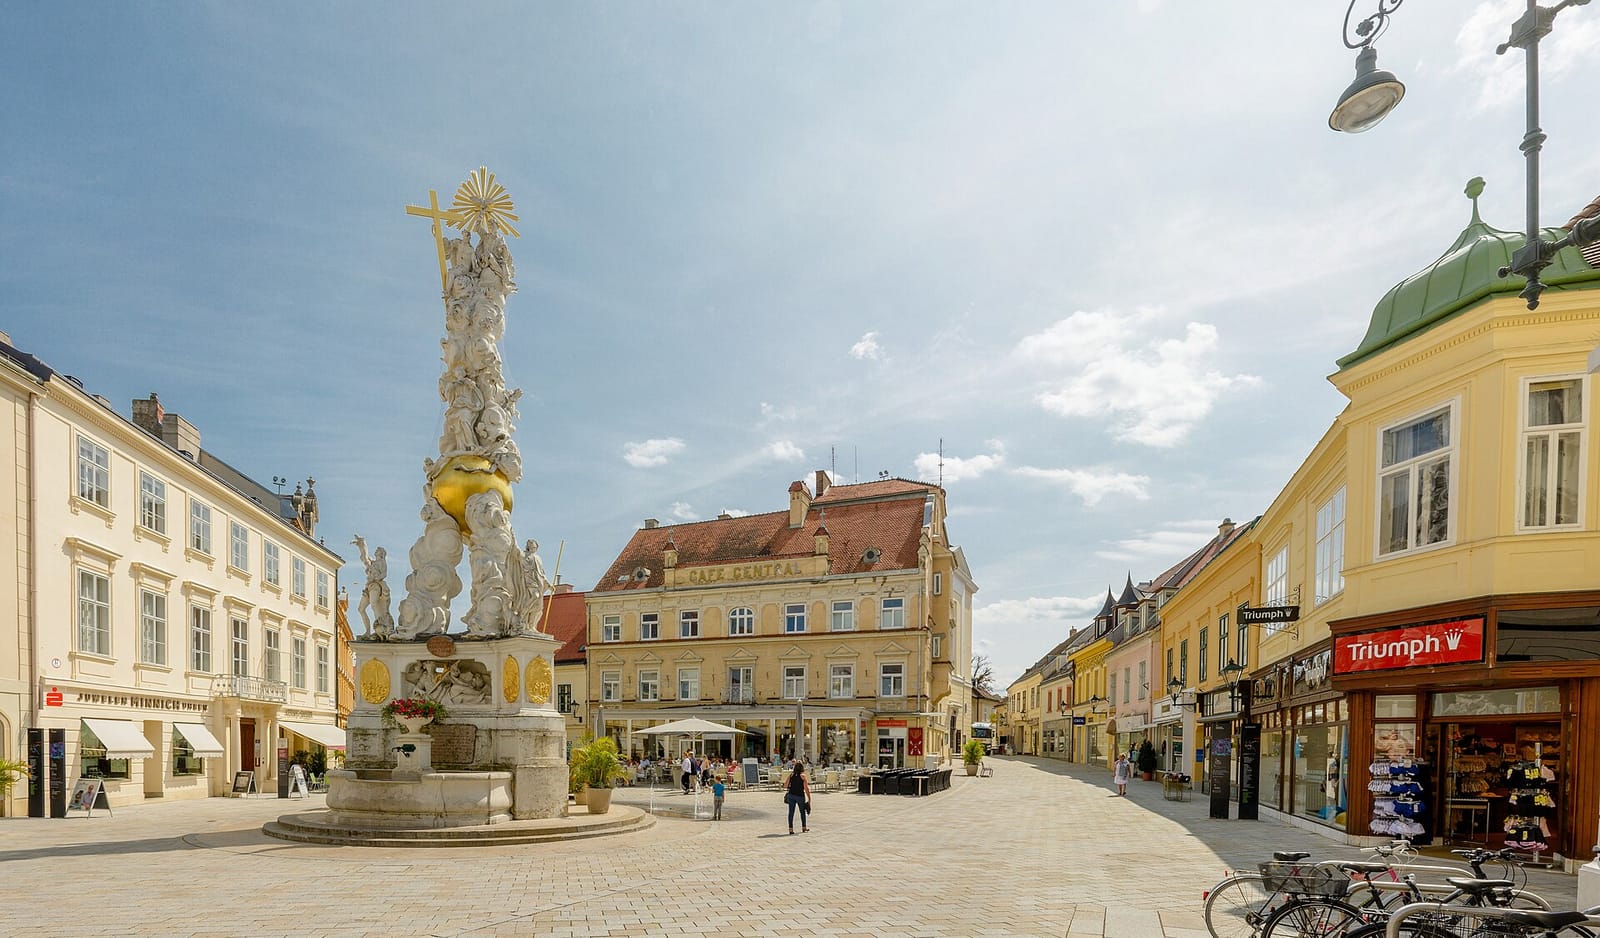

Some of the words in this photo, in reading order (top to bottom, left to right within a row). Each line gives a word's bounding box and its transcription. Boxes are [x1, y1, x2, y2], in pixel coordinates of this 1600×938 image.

[689, 568, 725, 583] CAFE
[733, 562, 802, 579] CENTRAL
[1243, 610, 1283, 620] Triumph
[1347, 634, 1441, 661] Triumph
